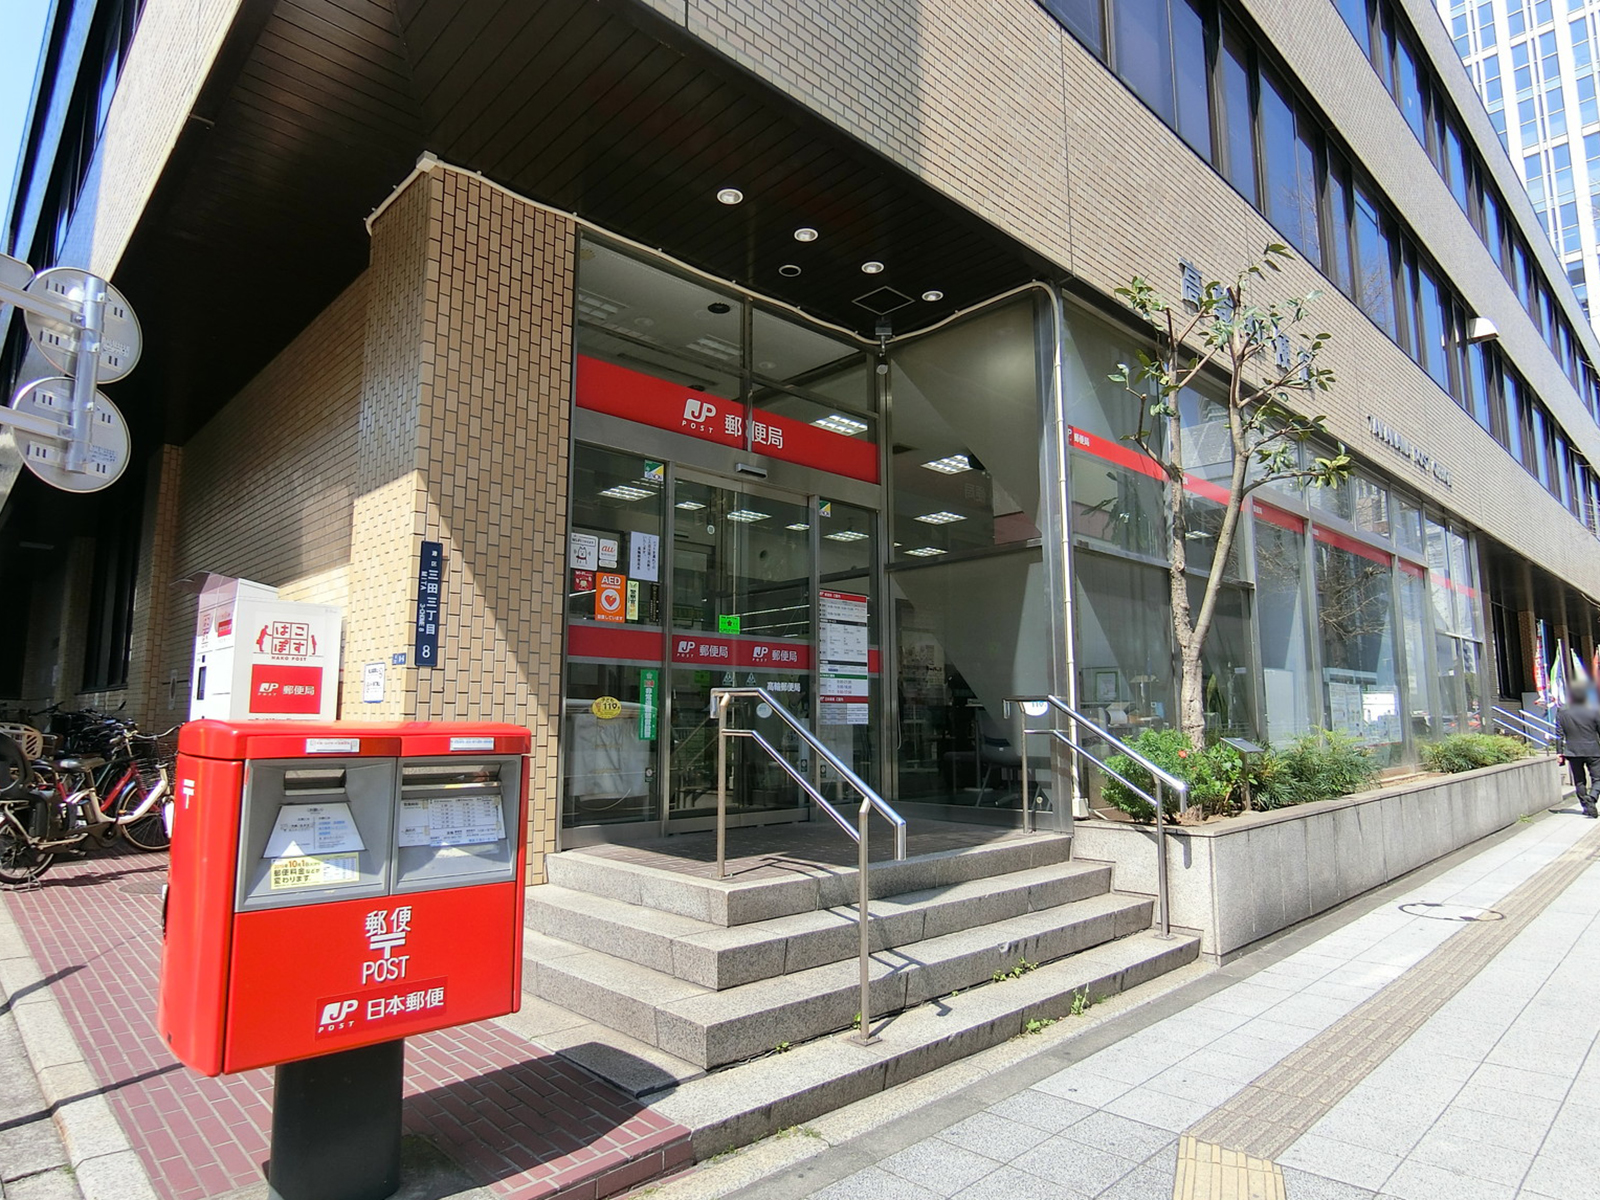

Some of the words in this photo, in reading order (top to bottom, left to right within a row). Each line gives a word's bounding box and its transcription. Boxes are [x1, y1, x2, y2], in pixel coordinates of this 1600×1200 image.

[681, 420, 714, 434] POST
[683, 398, 717, 423] JP
[724, 414, 784, 449] 郵便局
[602, 545, 615, 553] au
[420, 571, 428, 591] MITA
[602, 576, 621, 585] AED
[275, 624, 305, 636] はこ
[274, 640, 305, 654] ぽす
[421, 644, 431, 659] 8
[678, 641, 696, 654] JP
[699, 644, 729, 659] 郵便局
[752, 646, 769, 658] JP
[772, 649, 798, 662] 郵便局
[259, 683, 279, 692] JP
[282, 685, 314, 696] 郵便局
[766, 681, 800, 692] 高輪郵便局
[365, 906, 412, 936] 郵便
[362, 956, 410, 985] POST
[320, 999, 359, 1026] JP
[366, 986, 444, 1020] 日本郵便
[318, 1020, 355, 1034] POST
